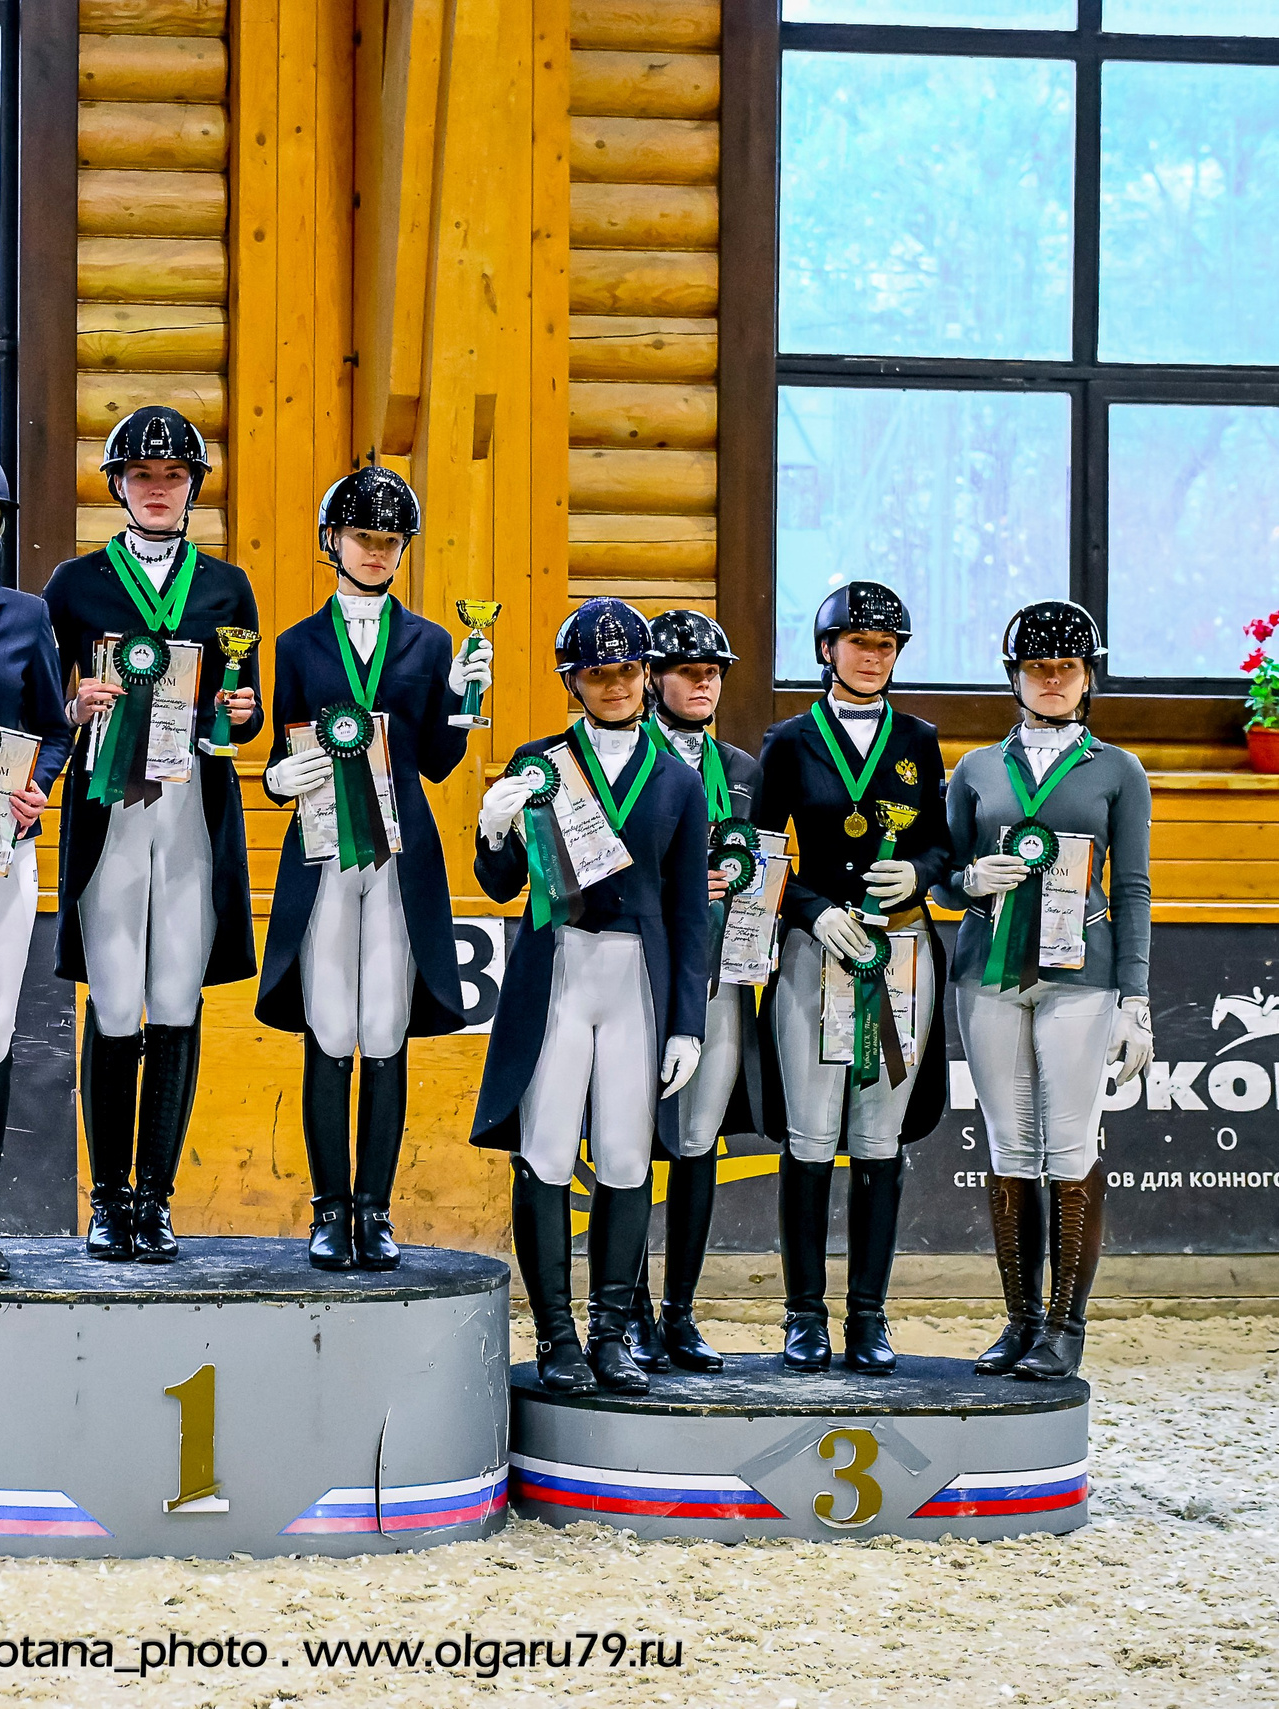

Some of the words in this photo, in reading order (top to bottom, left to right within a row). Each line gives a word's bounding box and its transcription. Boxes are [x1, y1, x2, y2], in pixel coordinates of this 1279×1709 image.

[1140, 1171, 1183, 1191] ДЛЯ
[163, 1363, 230, 1513] 1
[812, 1427, 884, 1530] 3
